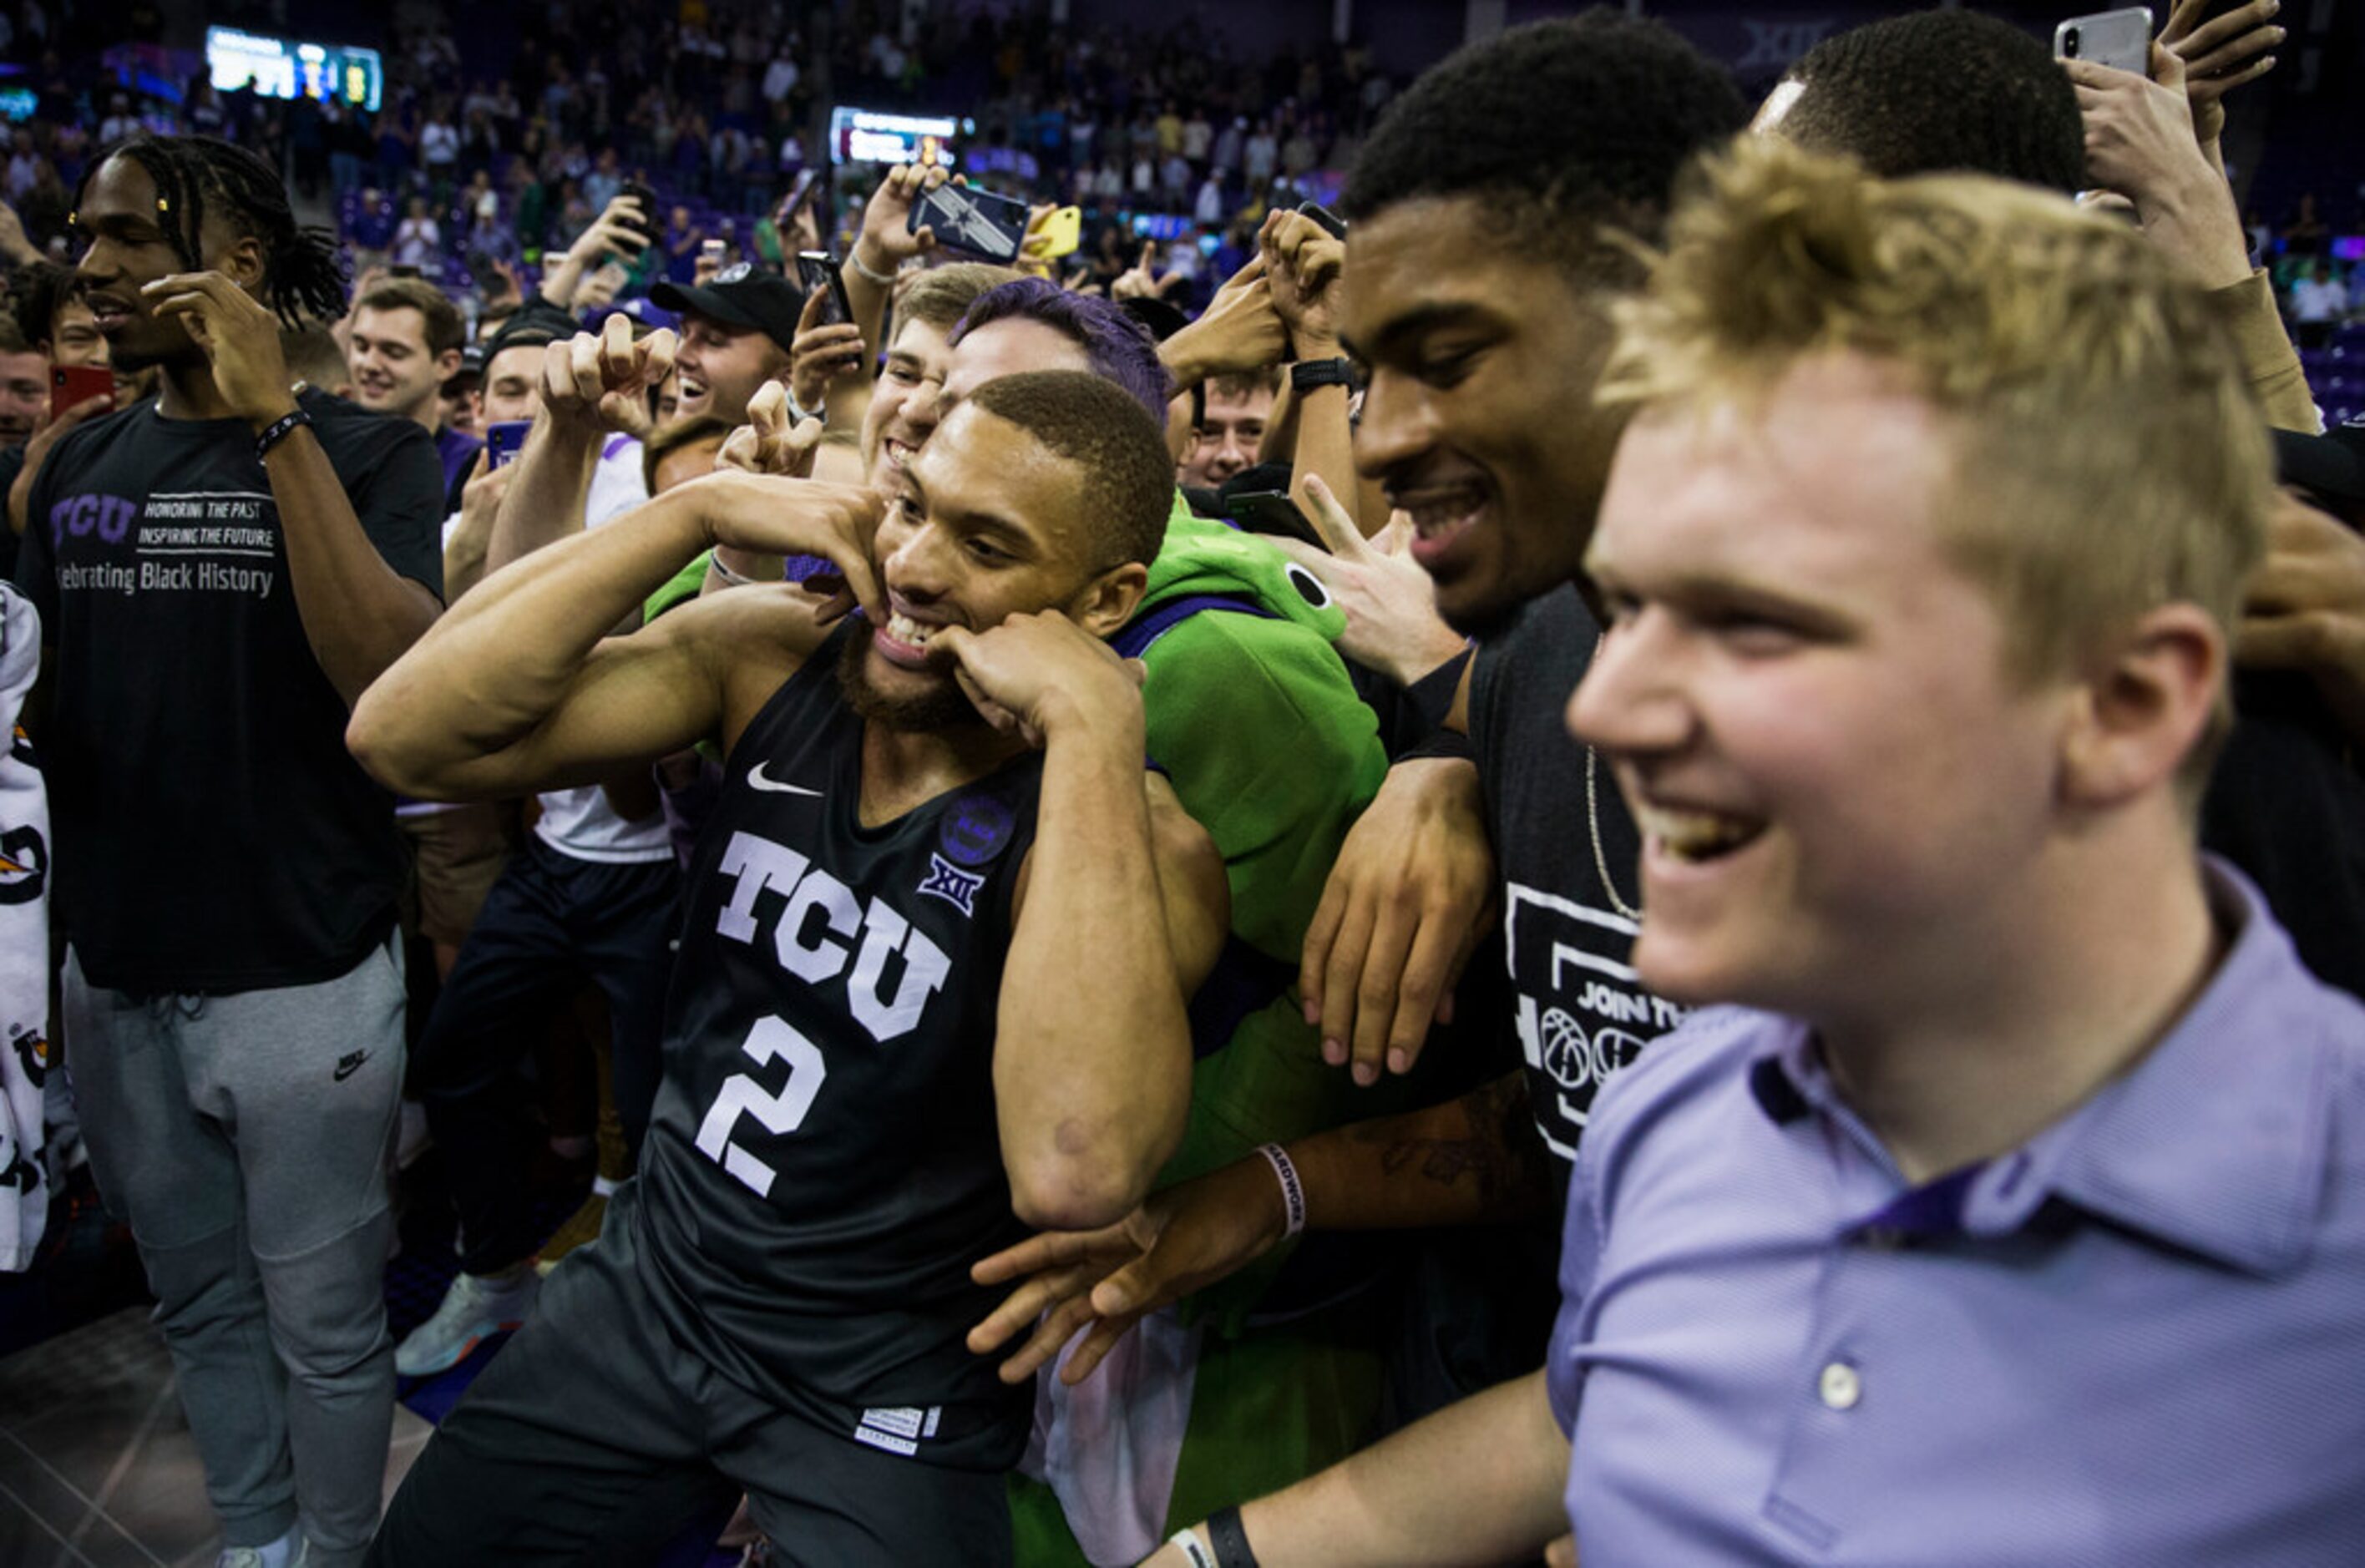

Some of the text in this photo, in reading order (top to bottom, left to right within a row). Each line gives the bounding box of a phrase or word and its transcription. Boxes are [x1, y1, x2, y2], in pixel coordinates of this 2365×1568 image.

[49, 493, 137, 549] TCU
[144, 501, 261, 519] HONORIN THE PAST
[199, 528, 223, 544] THE
[222, 528, 274, 548] FUTURE
[58, 561, 275, 599] ebrating Black History
[919, 852, 985, 917] XII
[716, 831, 953, 1043] TCU
[1577, 980, 1650, 1023] JOIN
[695, 1014, 826, 1199] 2
